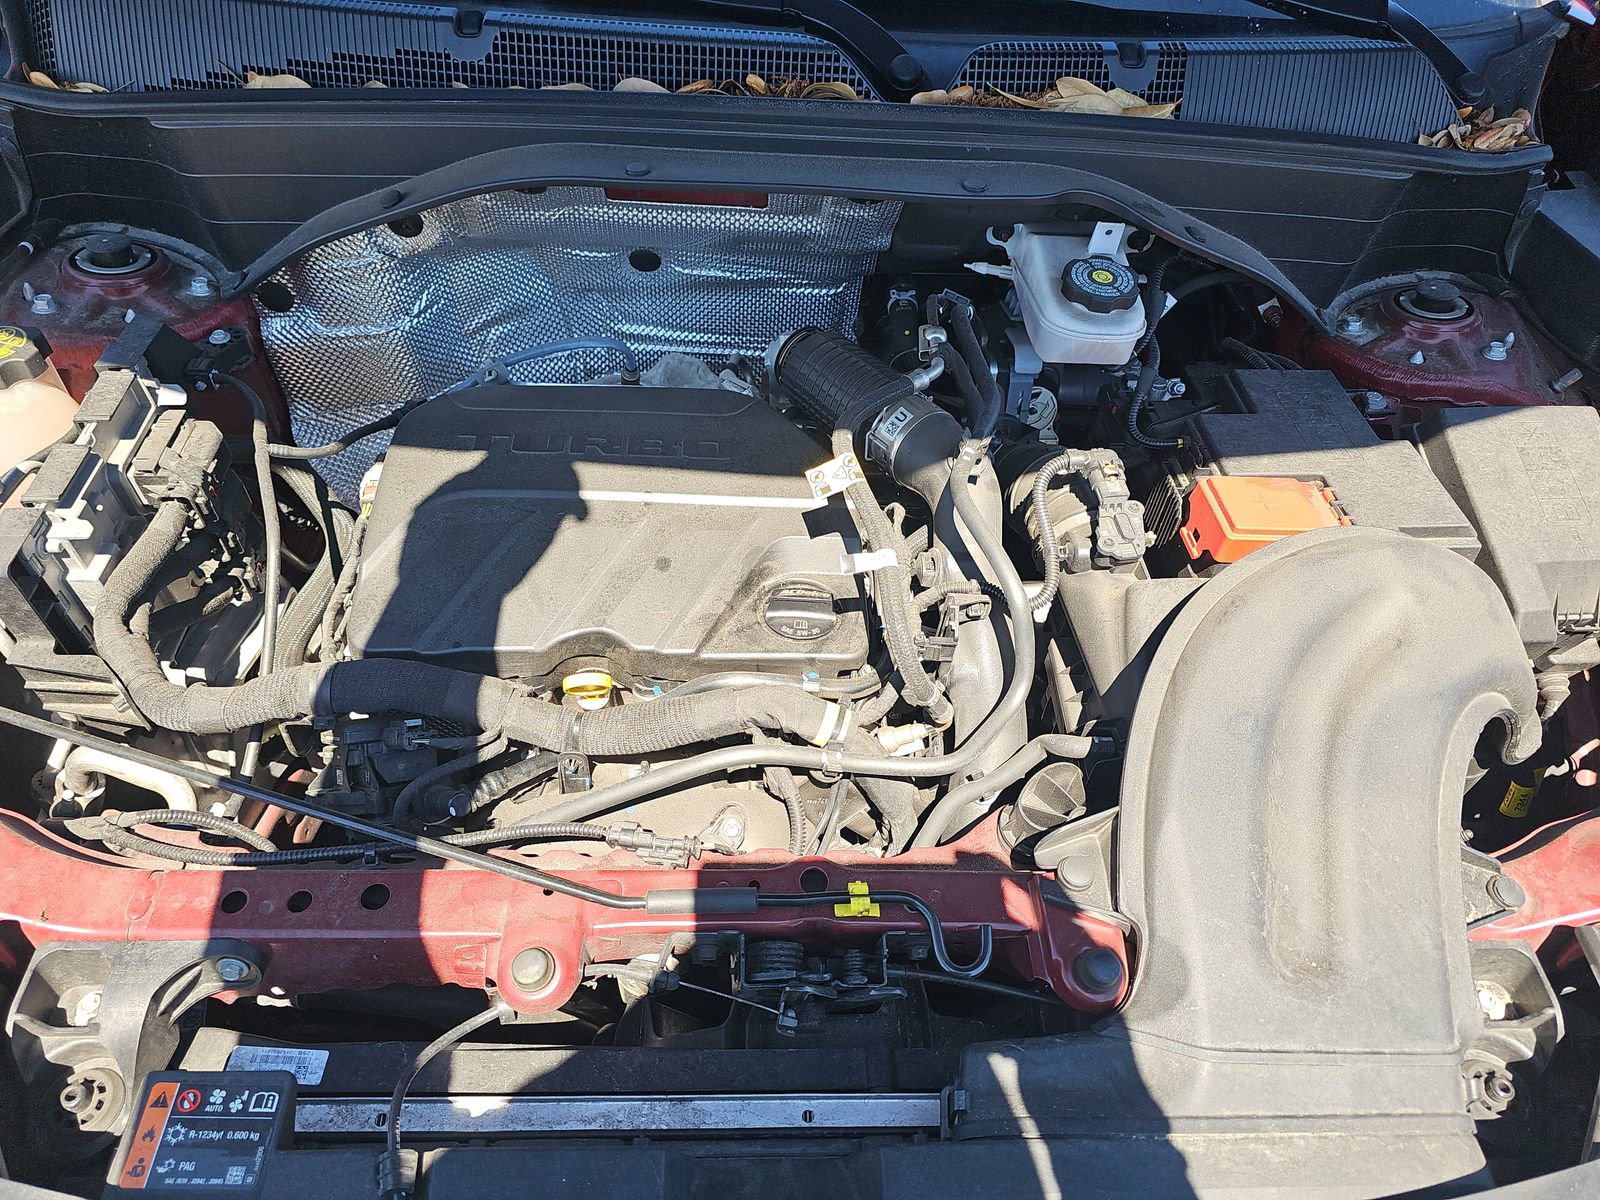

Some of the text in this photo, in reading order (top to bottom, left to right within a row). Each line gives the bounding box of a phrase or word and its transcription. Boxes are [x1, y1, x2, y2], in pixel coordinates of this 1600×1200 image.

[457, 434, 731, 460] TURBO
[780, 625, 795, 635] SAE
[205, 1104, 224, 1112] AUTO
[188, 1130, 260, 1141] R-1234yf 0.600 kg
[178, 1161, 196, 1171] PAG
